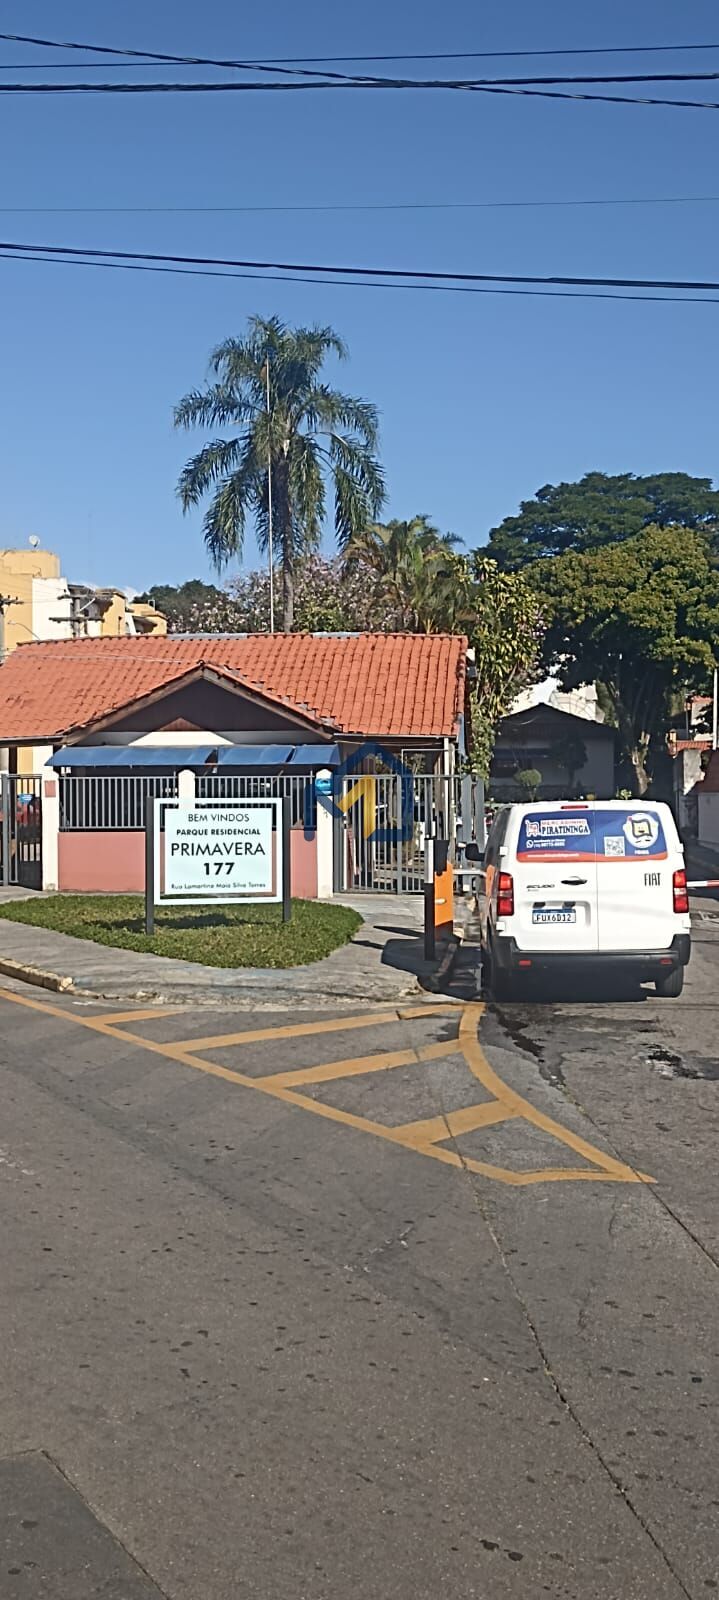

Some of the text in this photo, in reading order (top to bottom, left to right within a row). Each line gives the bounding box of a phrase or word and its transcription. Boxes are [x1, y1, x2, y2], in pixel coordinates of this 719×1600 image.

[188, 814, 250, 822] BEM VINDOS
[542, 825, 588, 834] PIRATININGA
[171, 842, 266, 856] PRIMAVERA
[204, 862, 235, 875] 177
[644, 872, 661, 886] FIAT
